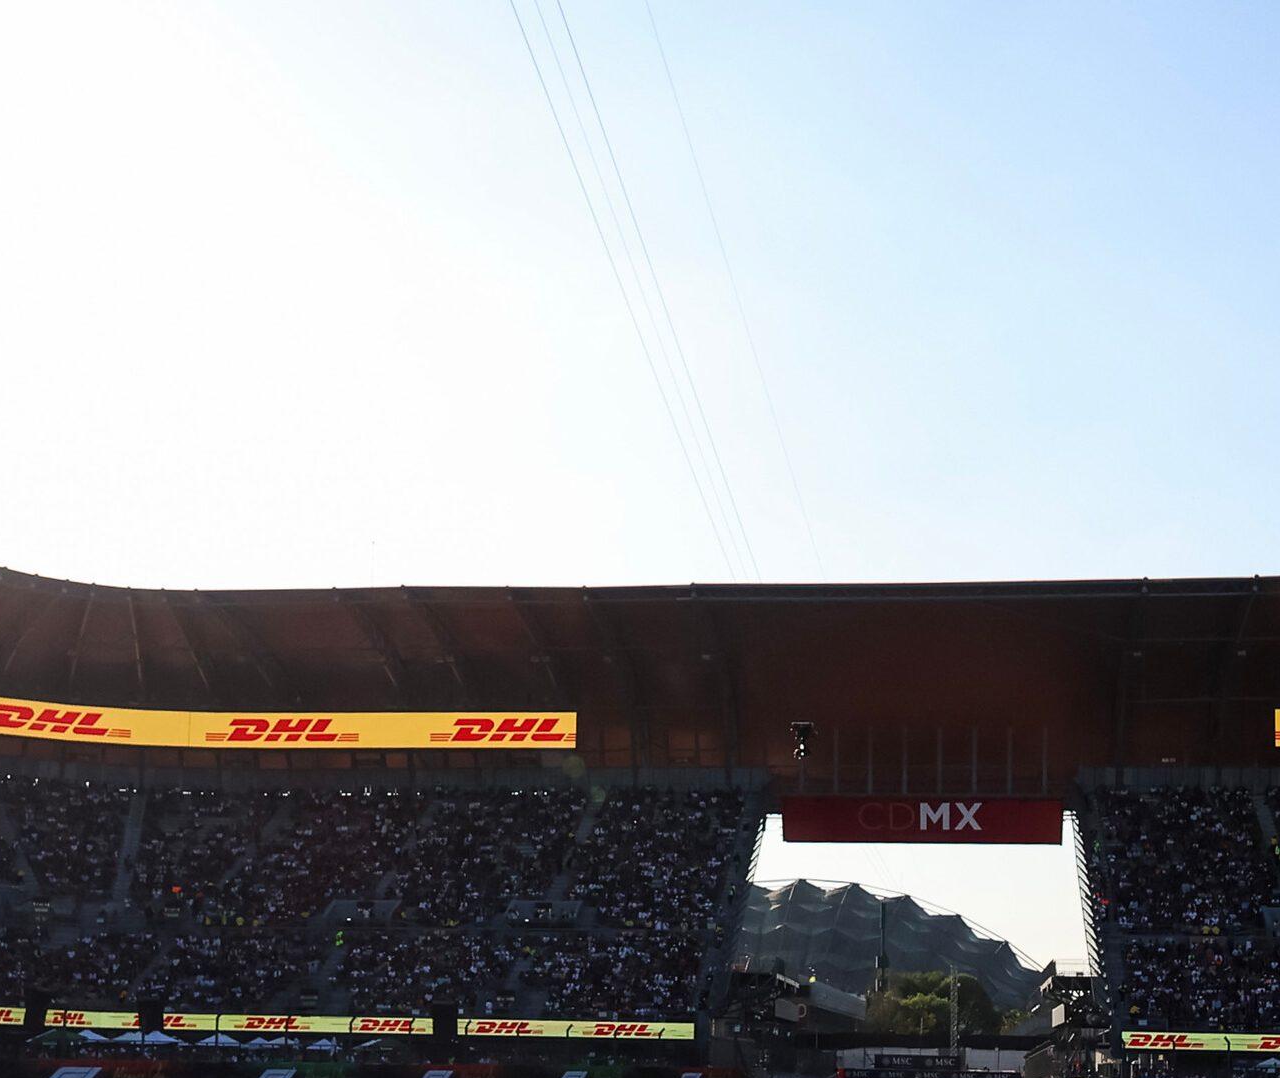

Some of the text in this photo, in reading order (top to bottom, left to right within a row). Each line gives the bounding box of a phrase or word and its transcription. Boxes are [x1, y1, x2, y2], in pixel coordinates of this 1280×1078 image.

[227, 718, 340, 742] DHL
[451, 718, 568, 742] DHL
[858, 802, 983, 831] CDMX
[52, 1011, 86, 1025] DHL
[244, 1017, 299, 1030] DHL
[359, 1019, 413, 1032] DHL
[475, 1021, 532, 1034] DHL
[593, 1023, 652, 1036] DHL
[1128, 1034, 1193, 1048] DHL
